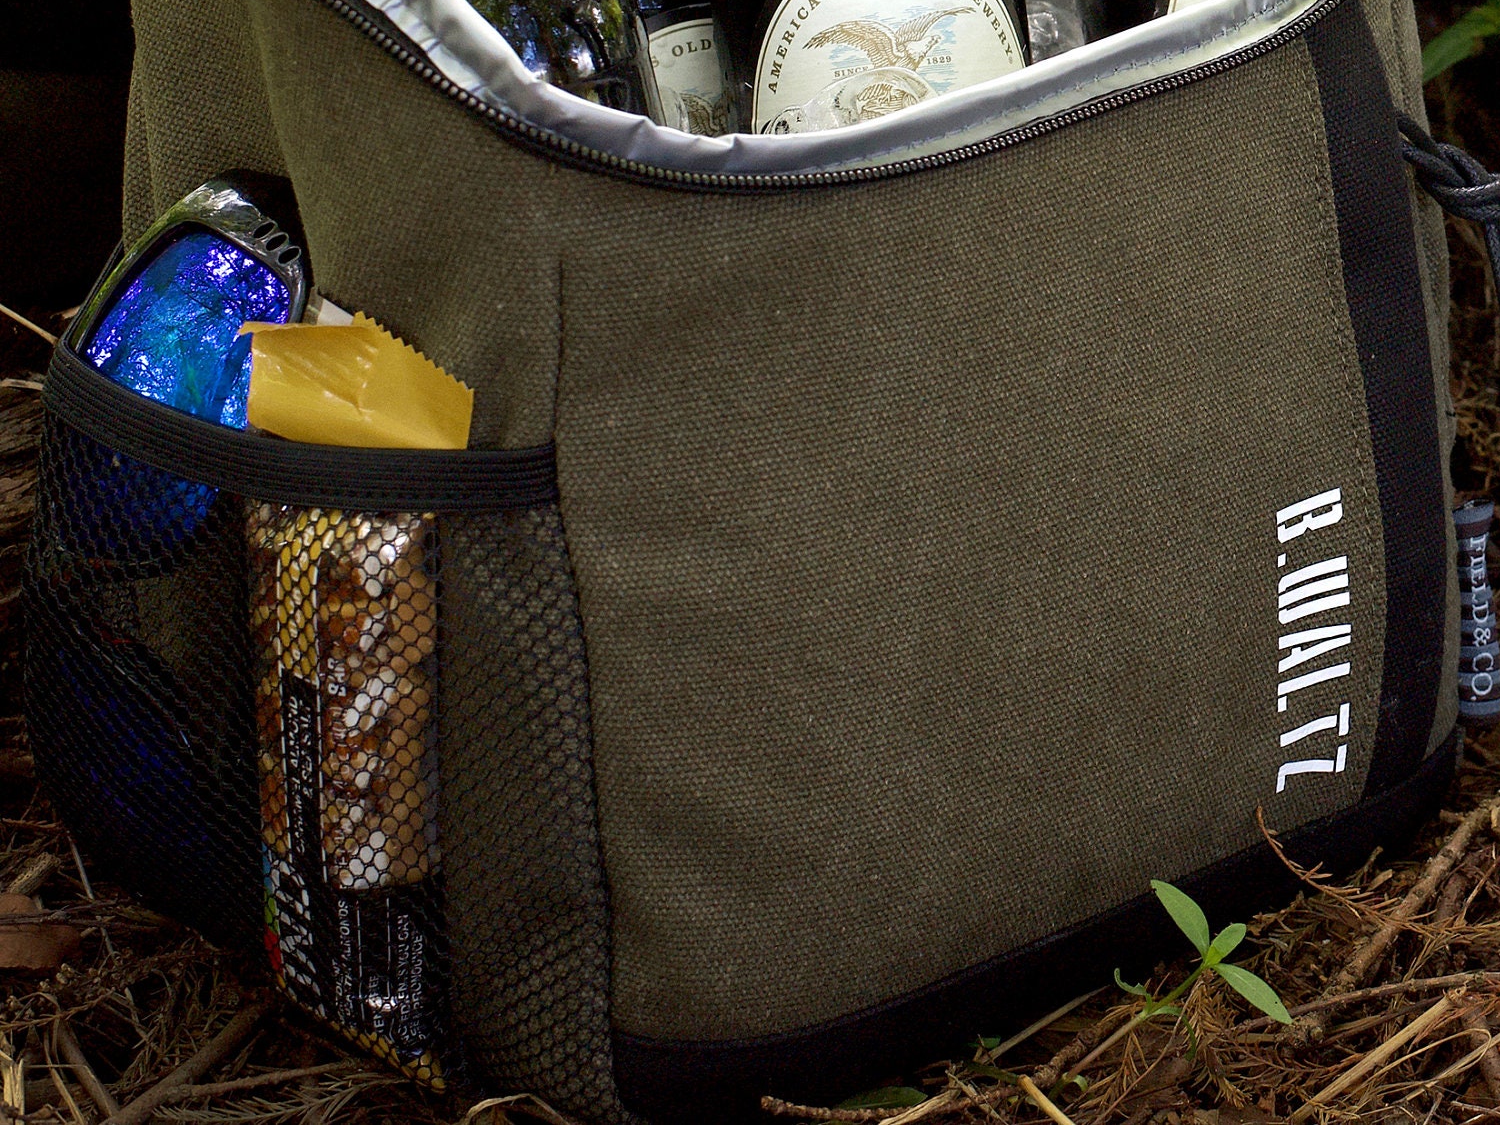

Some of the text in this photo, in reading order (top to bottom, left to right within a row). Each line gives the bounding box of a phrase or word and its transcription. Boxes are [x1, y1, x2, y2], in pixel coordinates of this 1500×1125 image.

[672, 38, 712, 57] OLD
[834, 55, 953, 79] SINCE 1829
[285, 695, 302, 767] ALMOND
